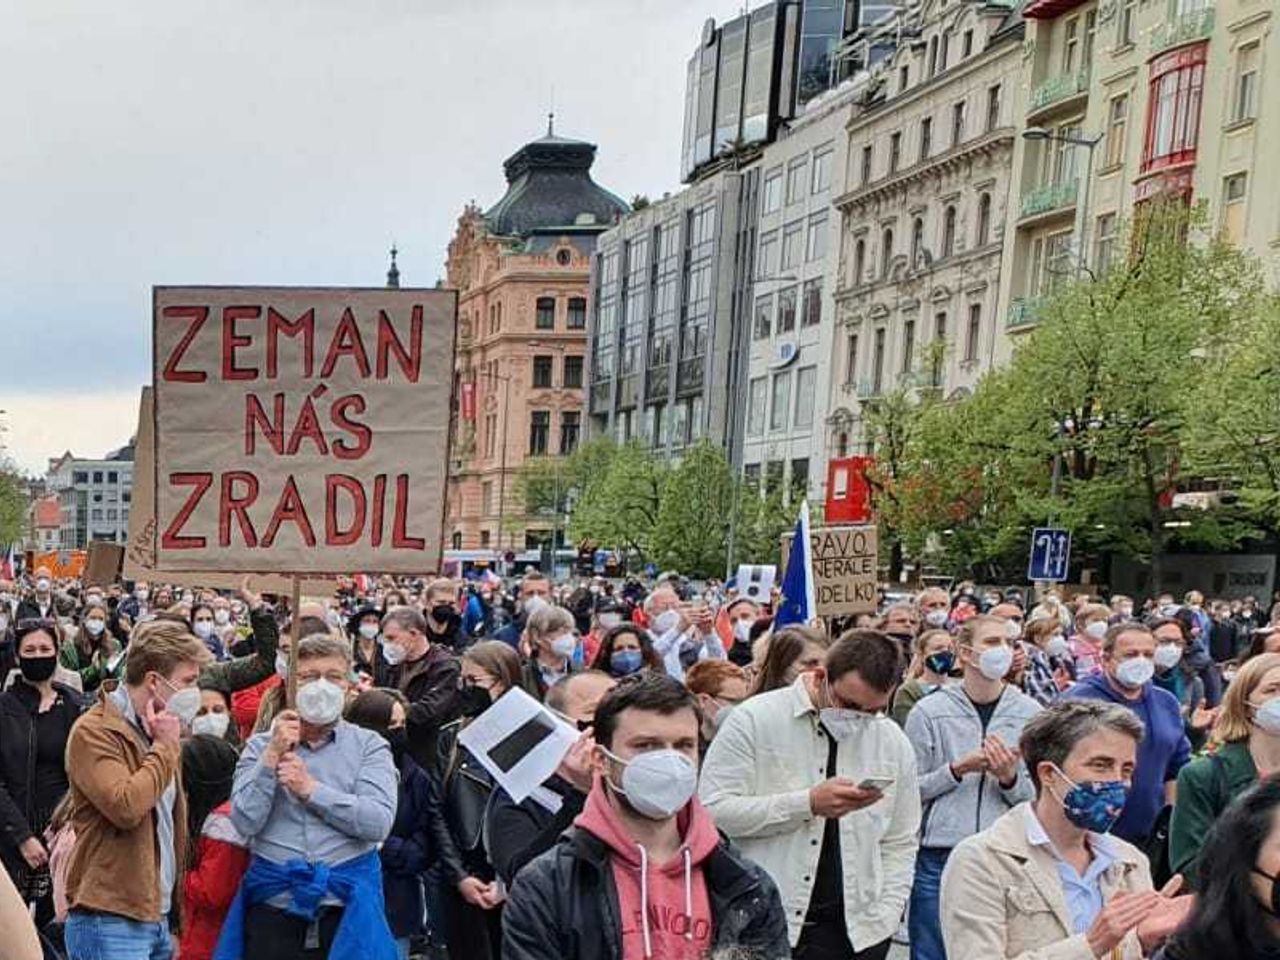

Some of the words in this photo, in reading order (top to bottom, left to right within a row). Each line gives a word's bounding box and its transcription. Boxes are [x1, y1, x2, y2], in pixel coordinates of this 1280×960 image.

[162, 304, 424, 384] ZEMAN
[244, 383, 373, 460] NÁS
[161, 471, 425, 550] ZRADIL
